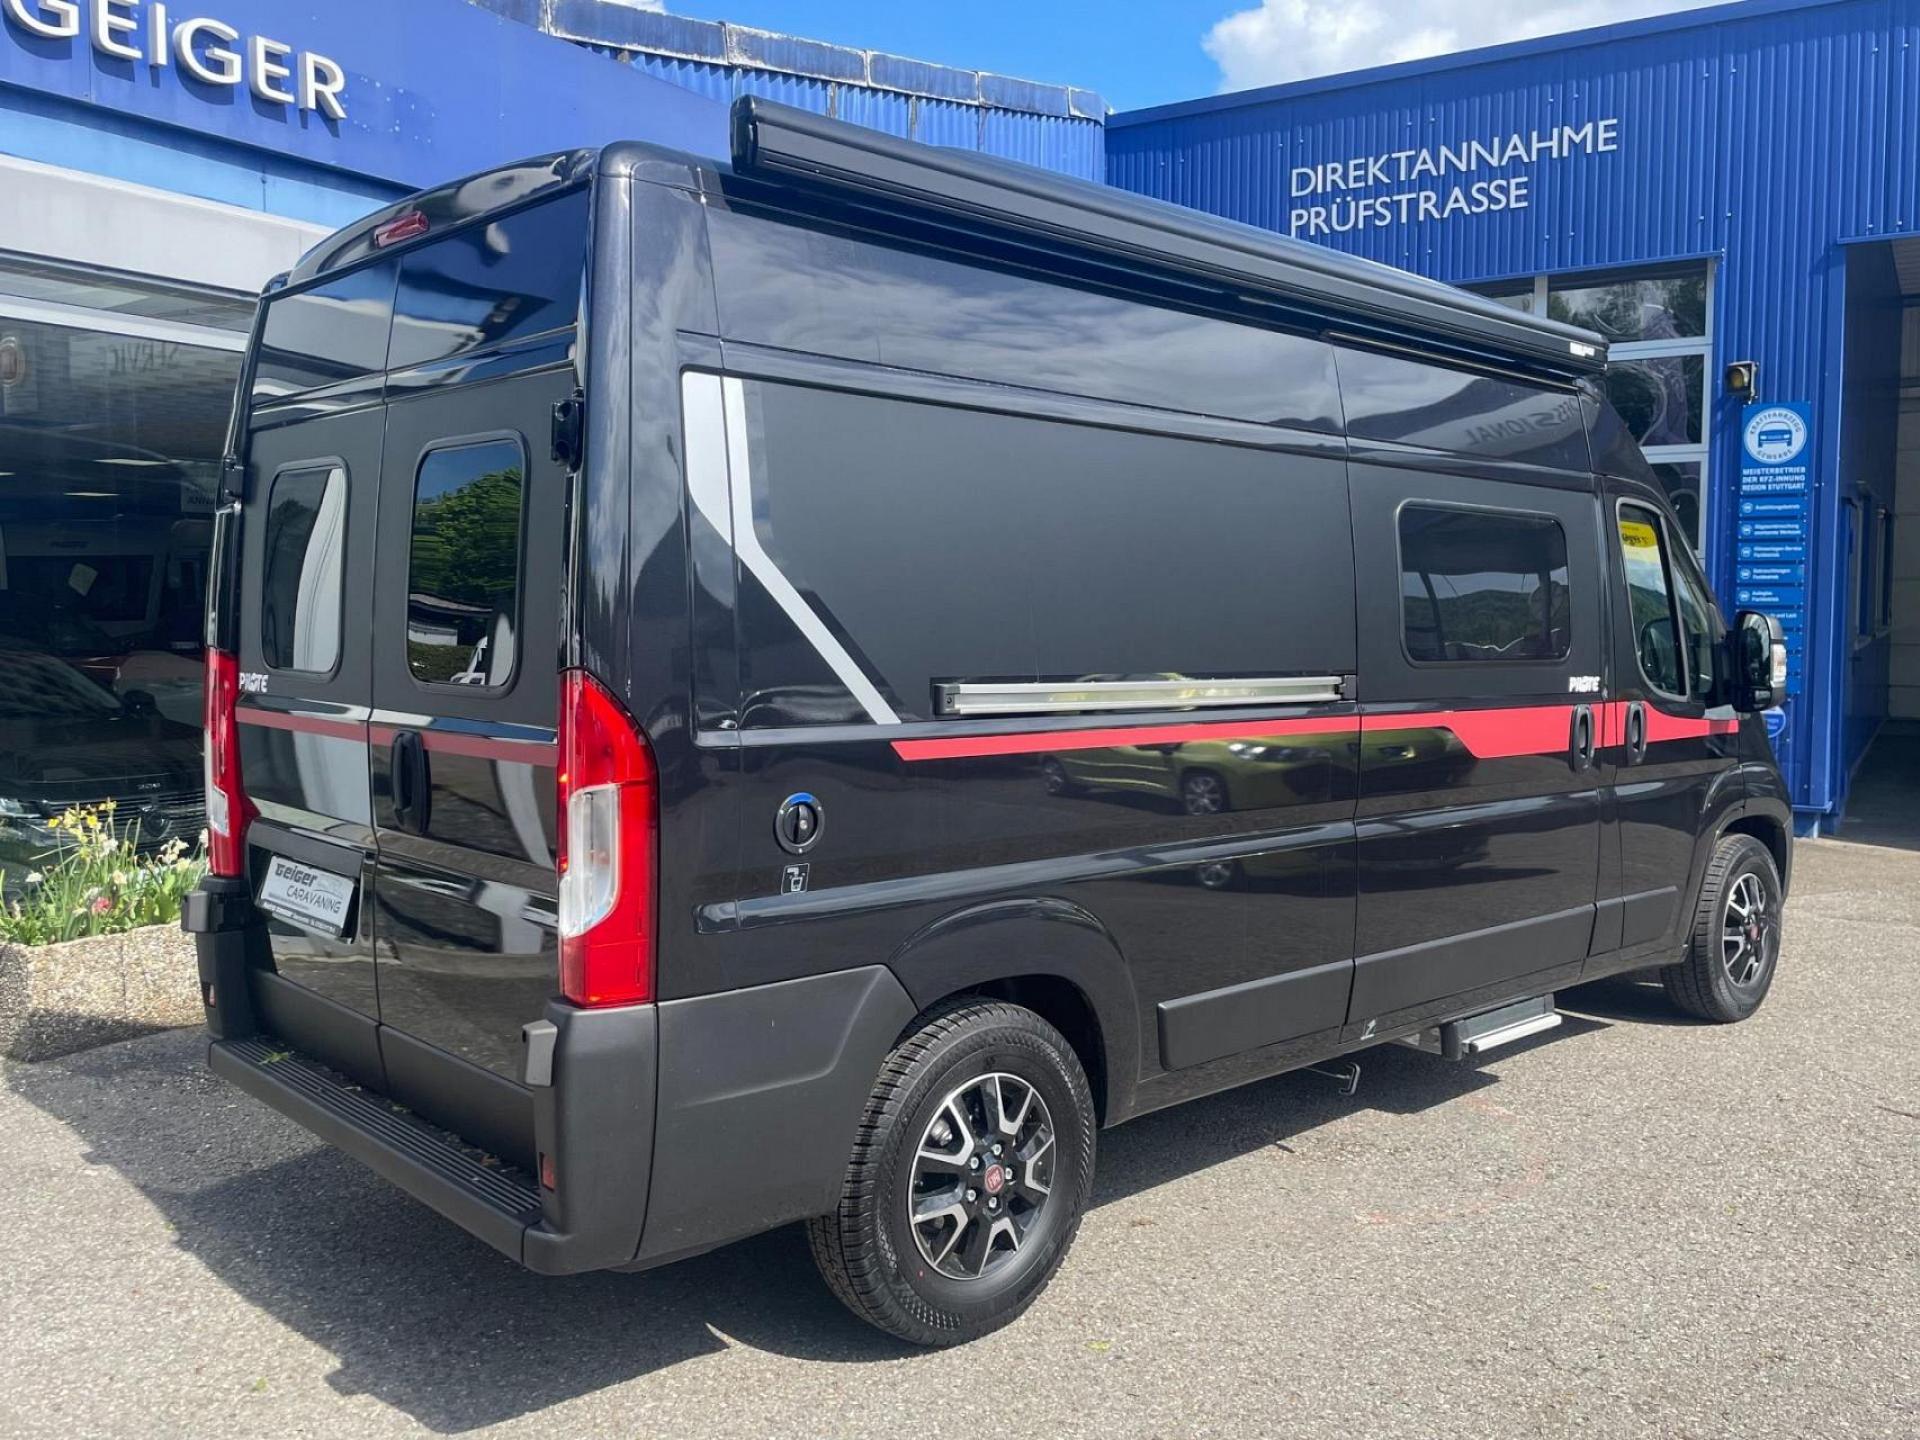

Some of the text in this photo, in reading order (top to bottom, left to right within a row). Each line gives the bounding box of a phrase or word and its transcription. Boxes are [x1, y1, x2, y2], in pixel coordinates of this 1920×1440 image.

[2, 0, 347, 119] GEIGER
[1291, 118, 1618, 197] DIREKTANNAHME
[1291, 176, 1528, 237] PRÜFSTRASSE
[1768, 482, 1805, 491] STUTTGART
[286, 885, 342, 914] CARAVANING
